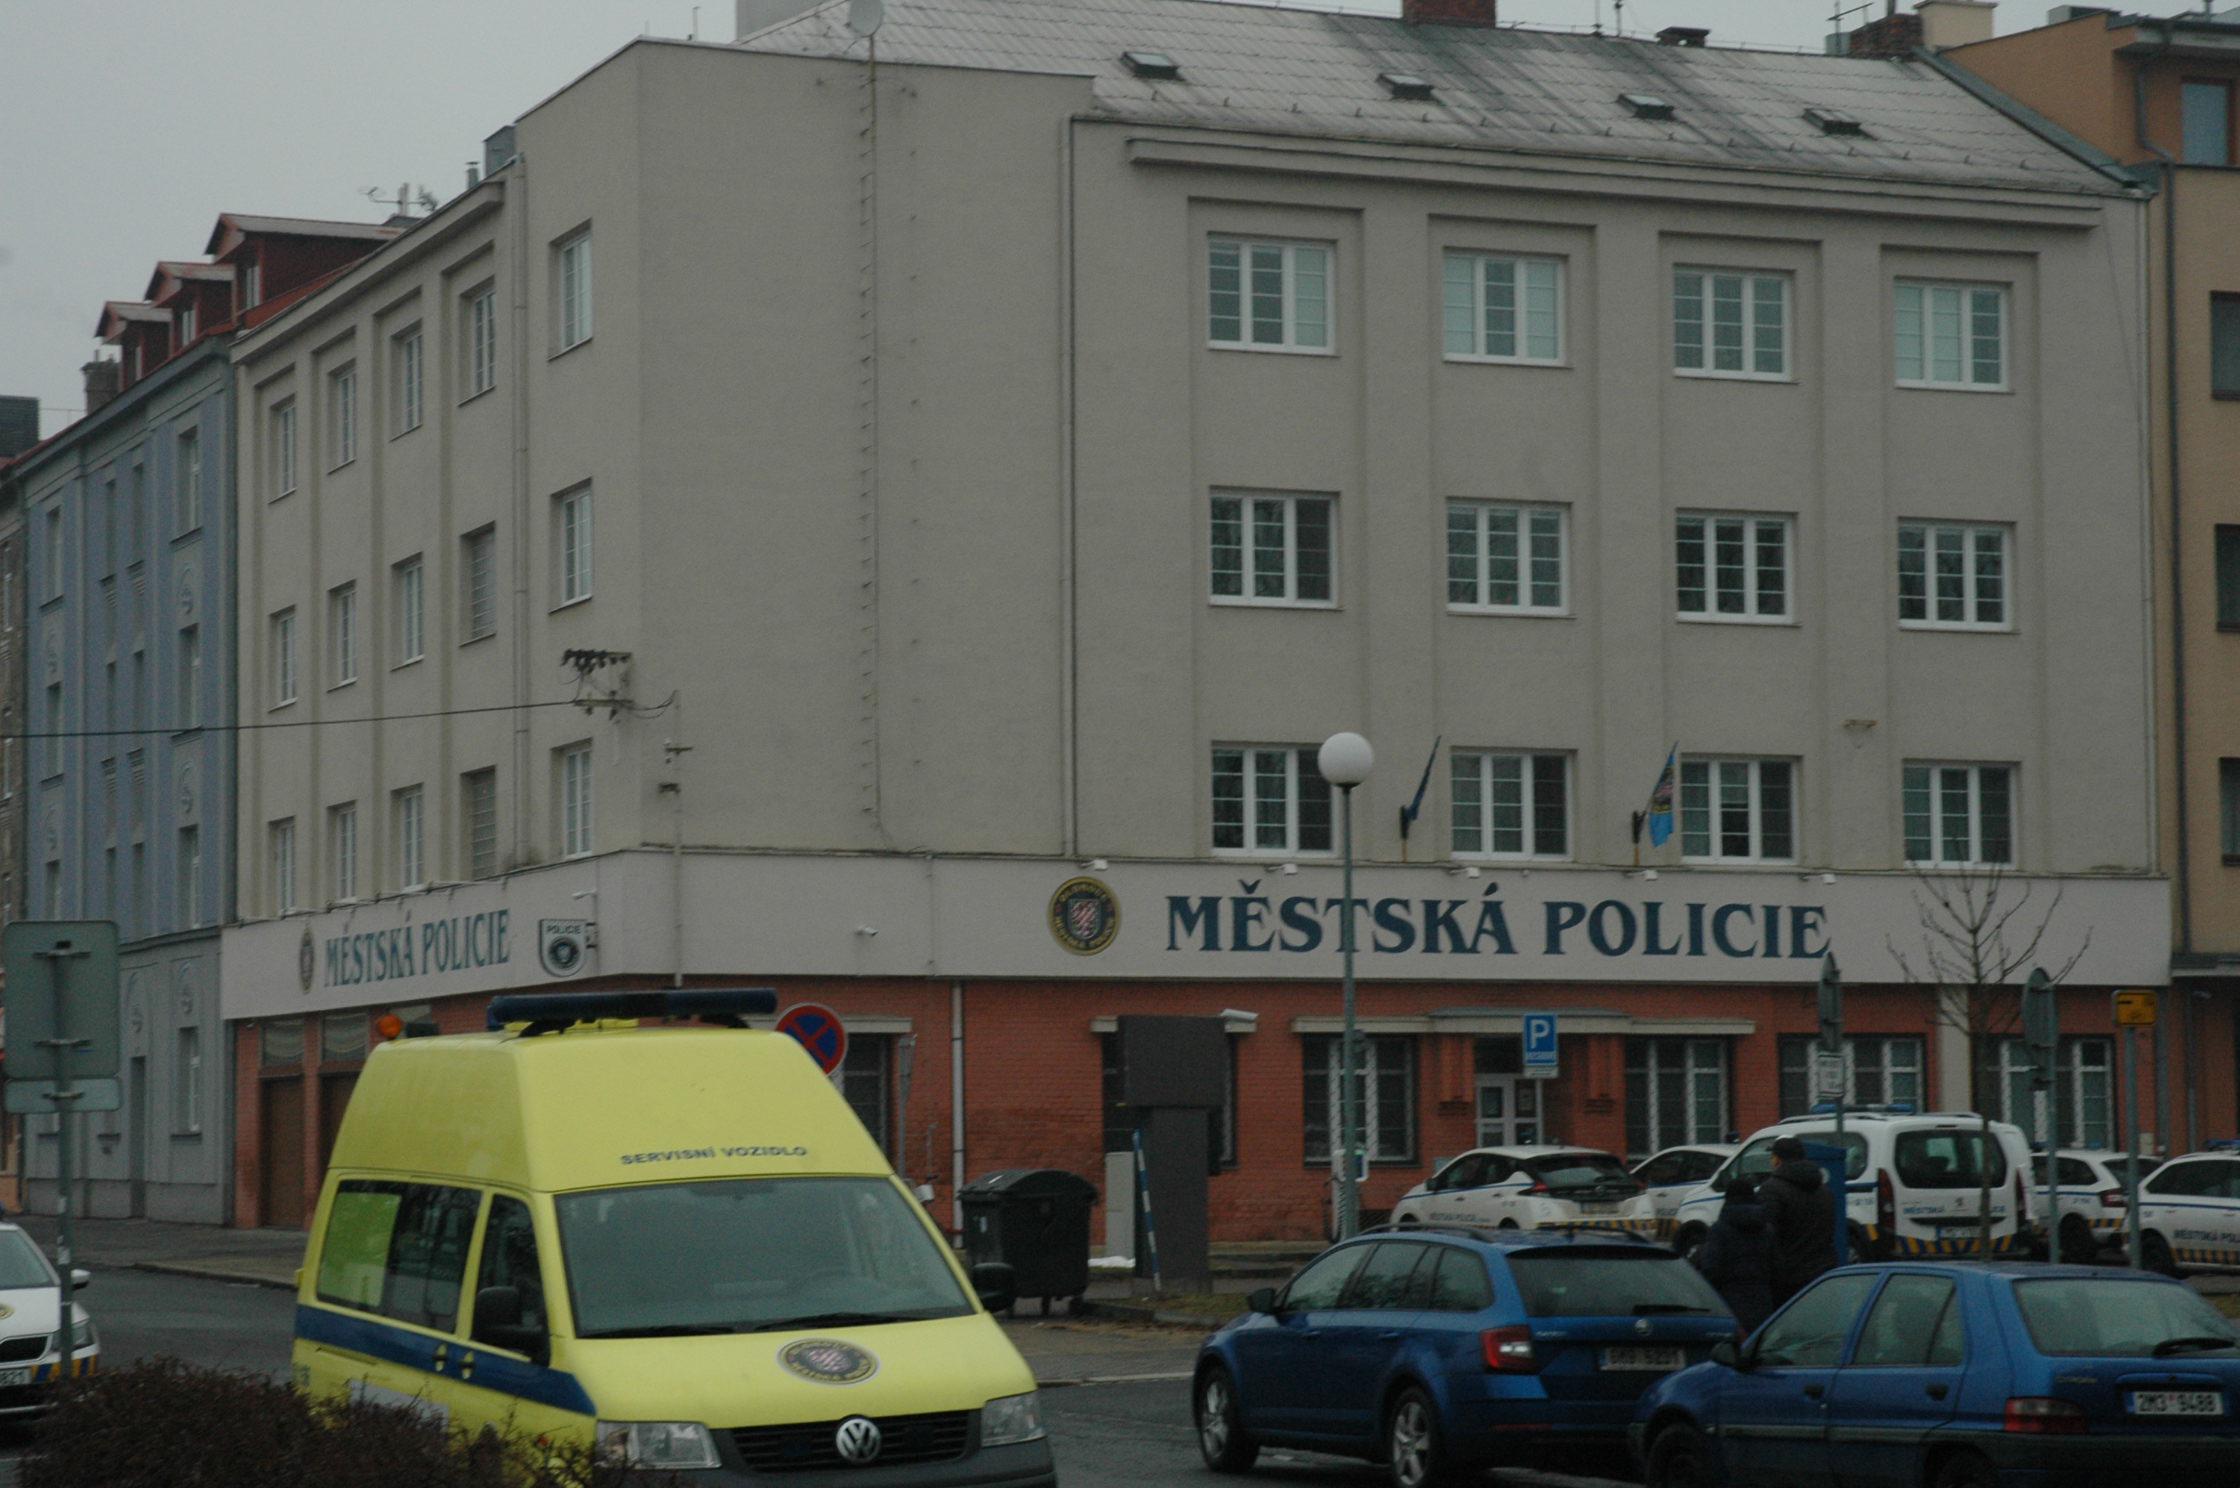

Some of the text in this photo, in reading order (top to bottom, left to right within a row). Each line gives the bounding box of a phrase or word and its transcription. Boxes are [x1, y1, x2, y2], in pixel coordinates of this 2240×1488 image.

[421, 908, 510, 976] POLICIE
[1165, 879, 1517, 954] MĚSTSKÁ
[1542, 899, 1831, 959] POLICIE
[1529, 1019, 1550, 1049] P
[721, 1146, 808, 1157] VOZIDLO
